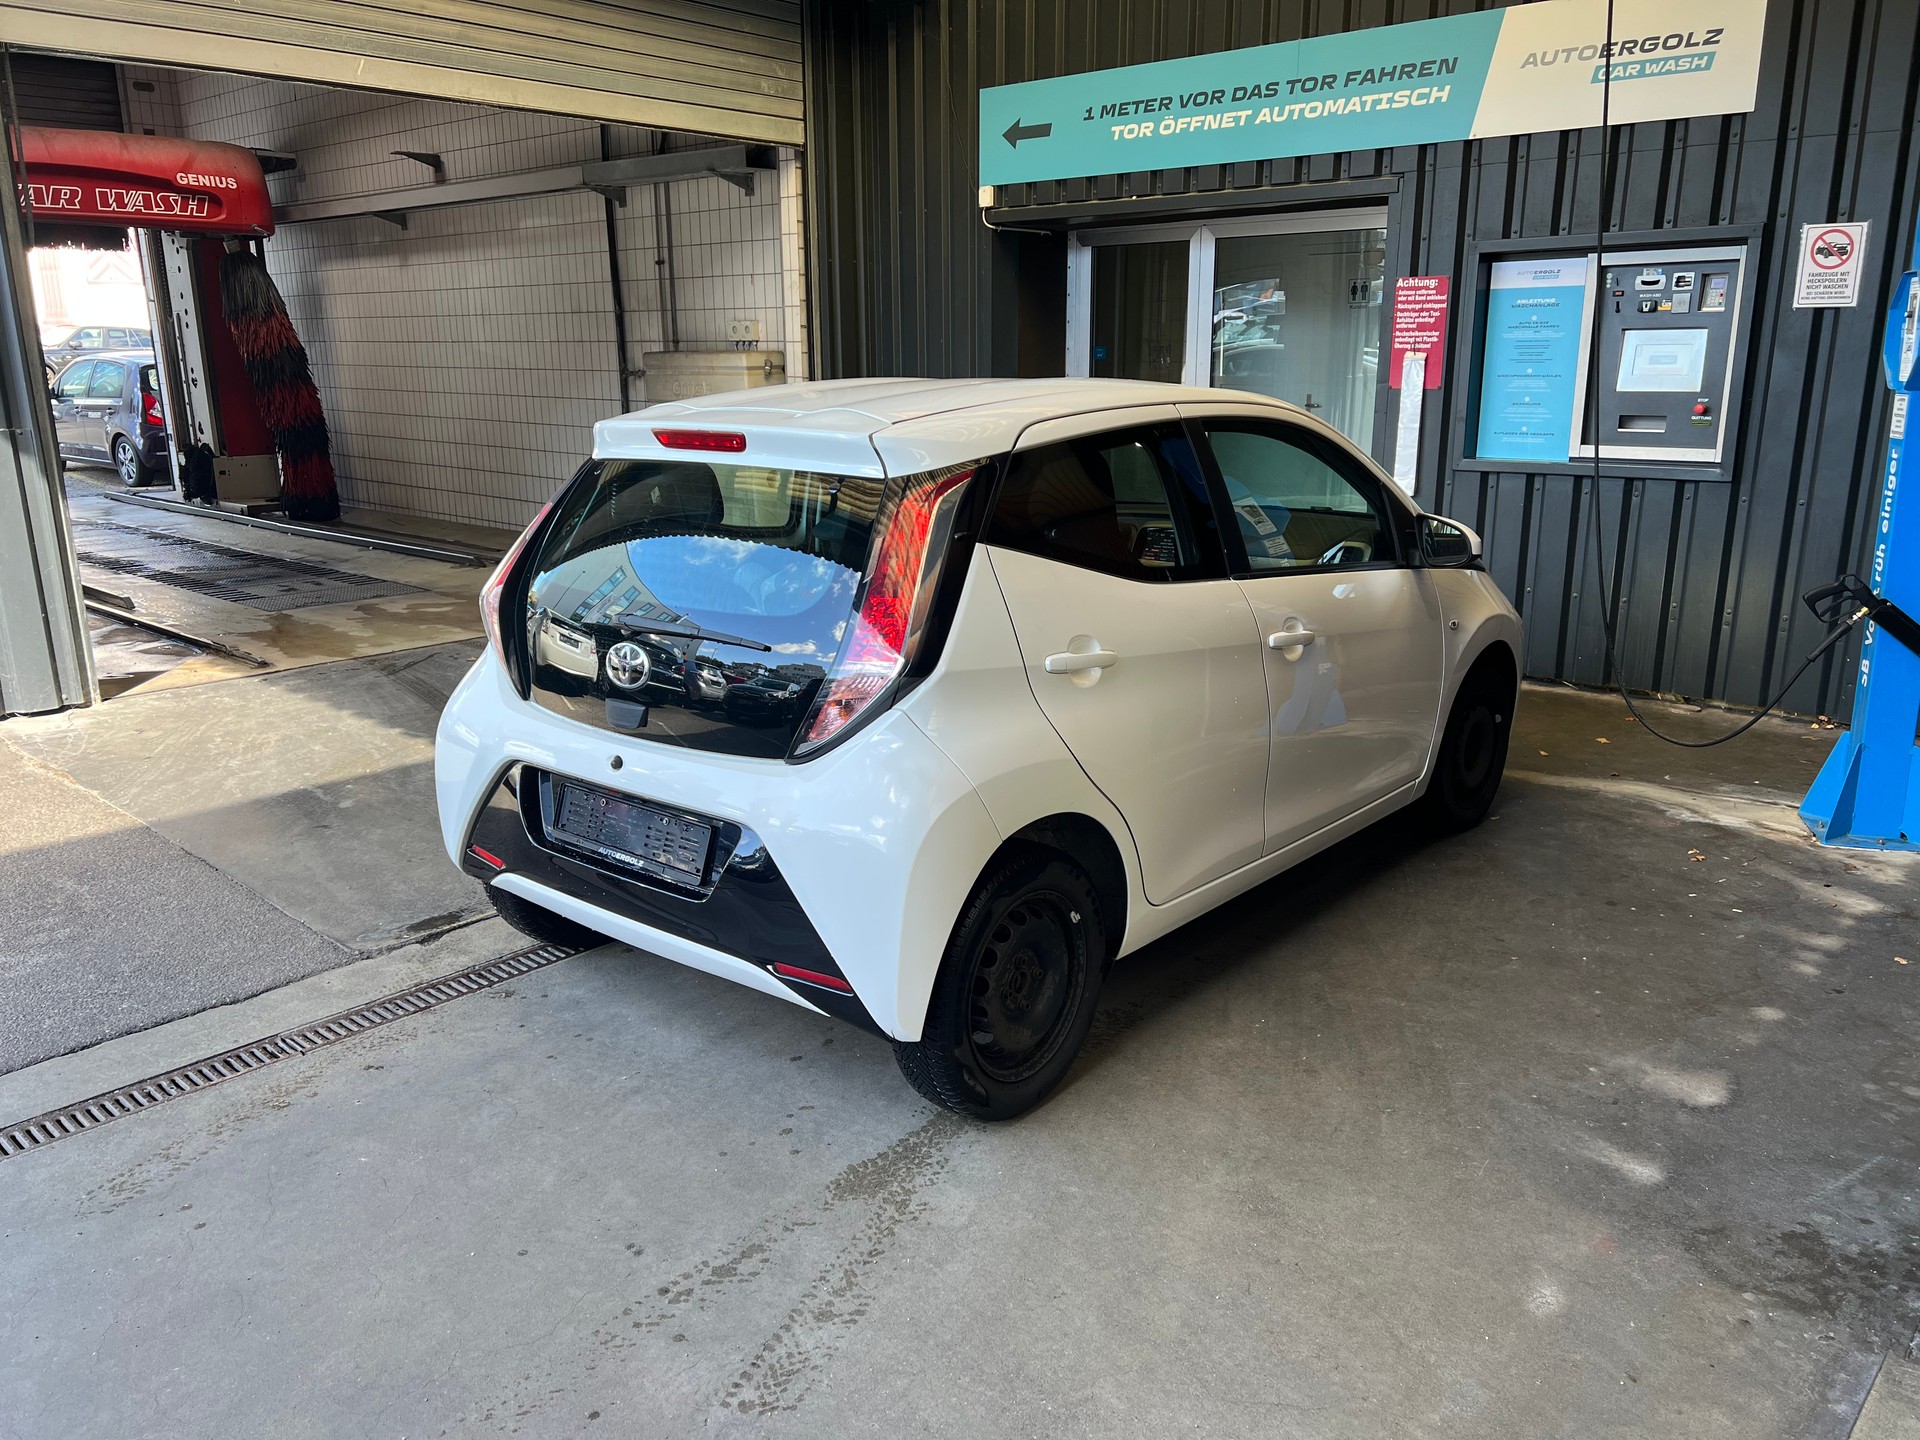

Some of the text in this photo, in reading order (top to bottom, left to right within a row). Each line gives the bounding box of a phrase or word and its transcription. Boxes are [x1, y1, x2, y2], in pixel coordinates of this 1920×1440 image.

[1520, 28, 1724, 69] AUTOERGOLZ
[1597, 55, 1708, 80] CAR WASH
[1083, 57, 1458, 121] 1 METER VOR DAS TOR FAHREN
[1111, 85, 1451, 141] TOR ÖFFNET AUTOMATISCH
[176, 172, 238, 189] GENIUS
[95, 188, 208, 216] WASH
[1397, 278, 1438, 288] Achtung:
[598, 847, 645, 867] AUTOERGOLZ
